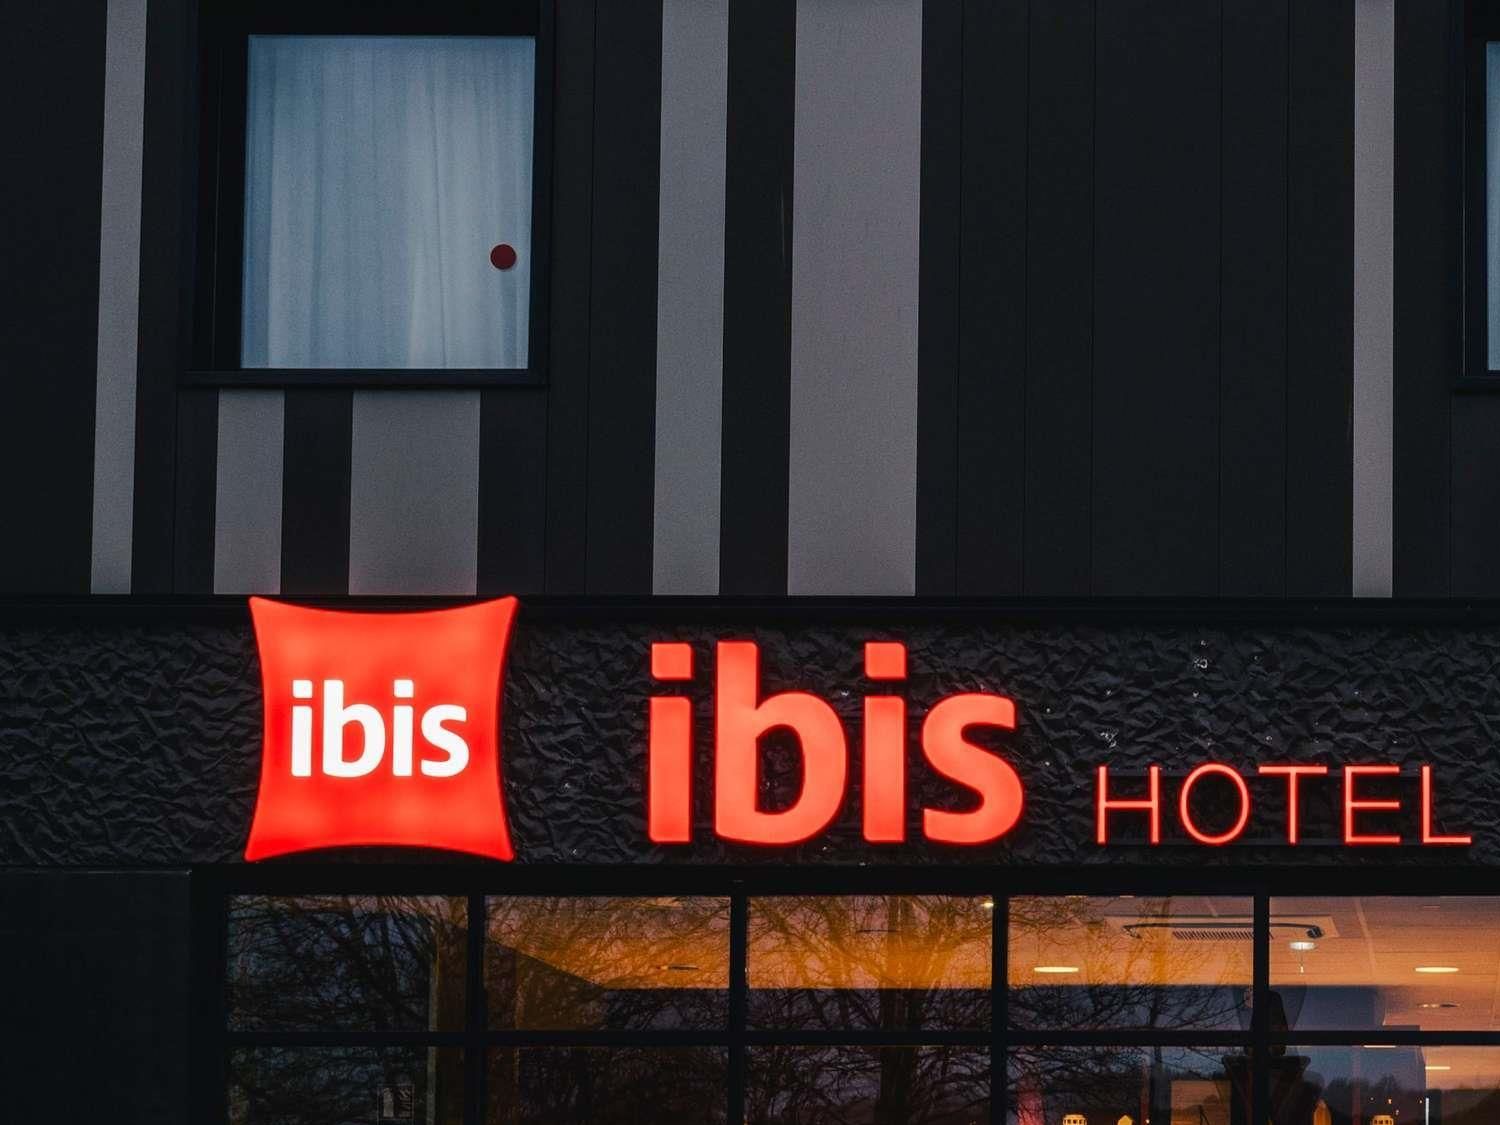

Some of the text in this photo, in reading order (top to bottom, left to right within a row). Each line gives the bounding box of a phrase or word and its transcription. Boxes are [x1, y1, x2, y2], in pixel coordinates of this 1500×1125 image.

[291, 679, 469, 778] ibis
[648, 641, 1472, 845] ibis HOTEL
